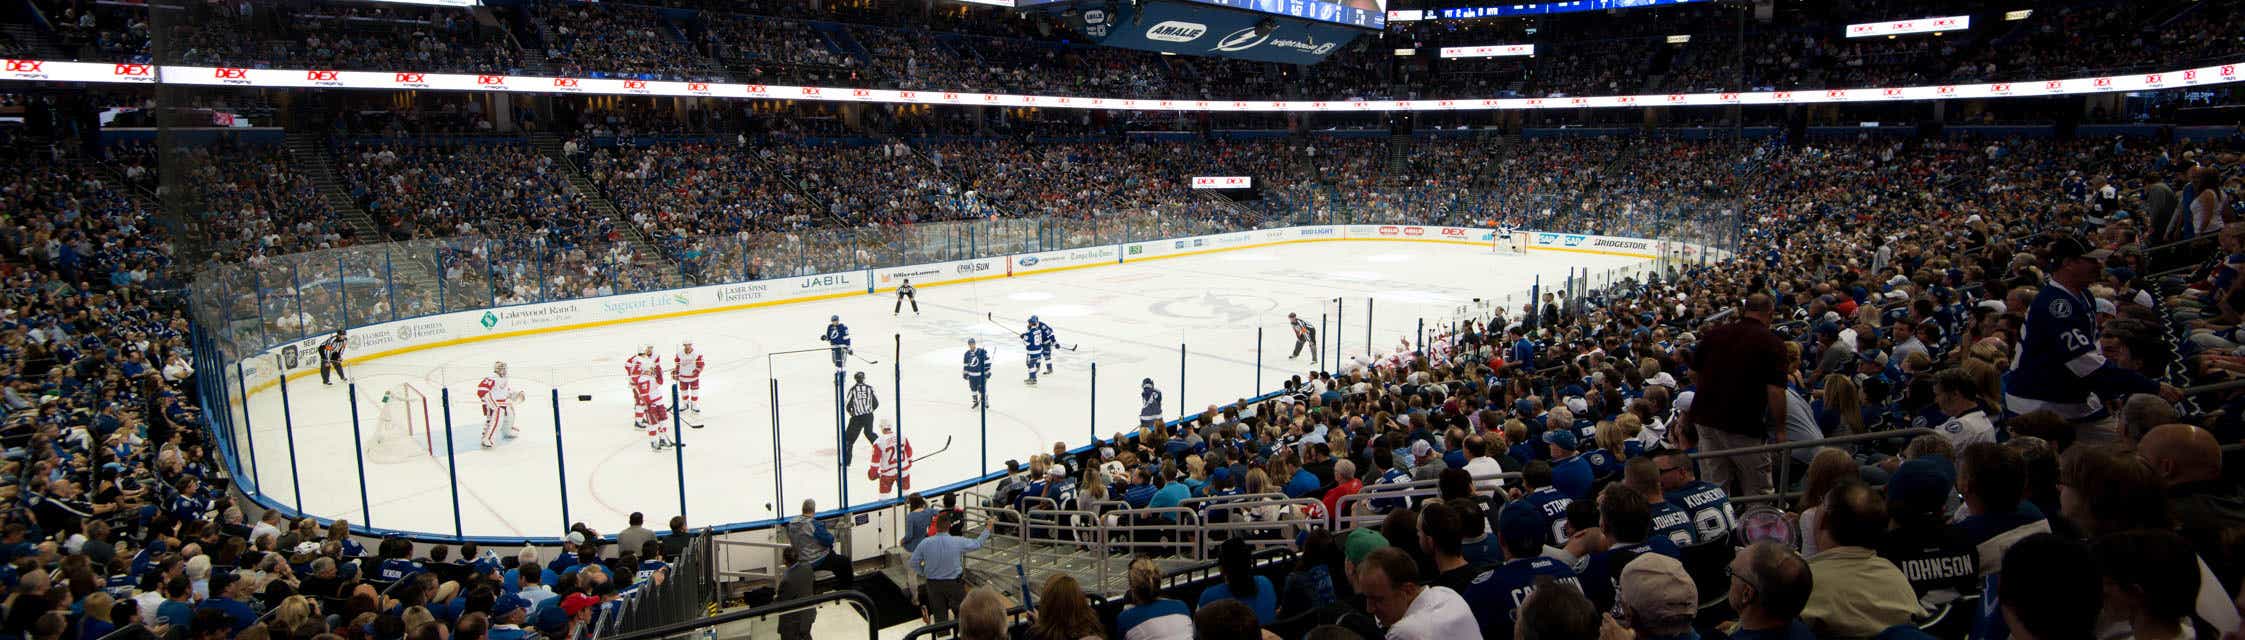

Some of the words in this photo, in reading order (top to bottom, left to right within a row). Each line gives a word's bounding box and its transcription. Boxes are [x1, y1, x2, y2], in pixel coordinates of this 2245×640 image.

[1152, 25, 1202, 38] AMALIE
[4, 59, 44, 73] DEX
[114, 64, 152, 76] DEX
[214, 68, 249, 80] DEX
[307, 70, 340, 81] DEX
[395, 73, 425, 83] DEX
[477, 75, 505, 85] DEX
[554, 78, 578, 88] DEX
[624, 80, 648, 90] DEX
[688, 82, 709, 91] DEX
[1441, 228, 1465, 236] DEX
[1594, 239, 1647, 250] BRIDGESTONE
[976, 263, 990, 272] SUN
[801, 275, 849, 288] JABIL
[500, 306, 547, 320] Lakewood
[303, 339, 317, 348] NEW
[2060, 328, 2089, 350] 26
[300, 347, 320, 359] OFFICIA
[1653, 511, 1690, 530] JOHNSO
[1902, 554, 1974, 581] JOHNSON
